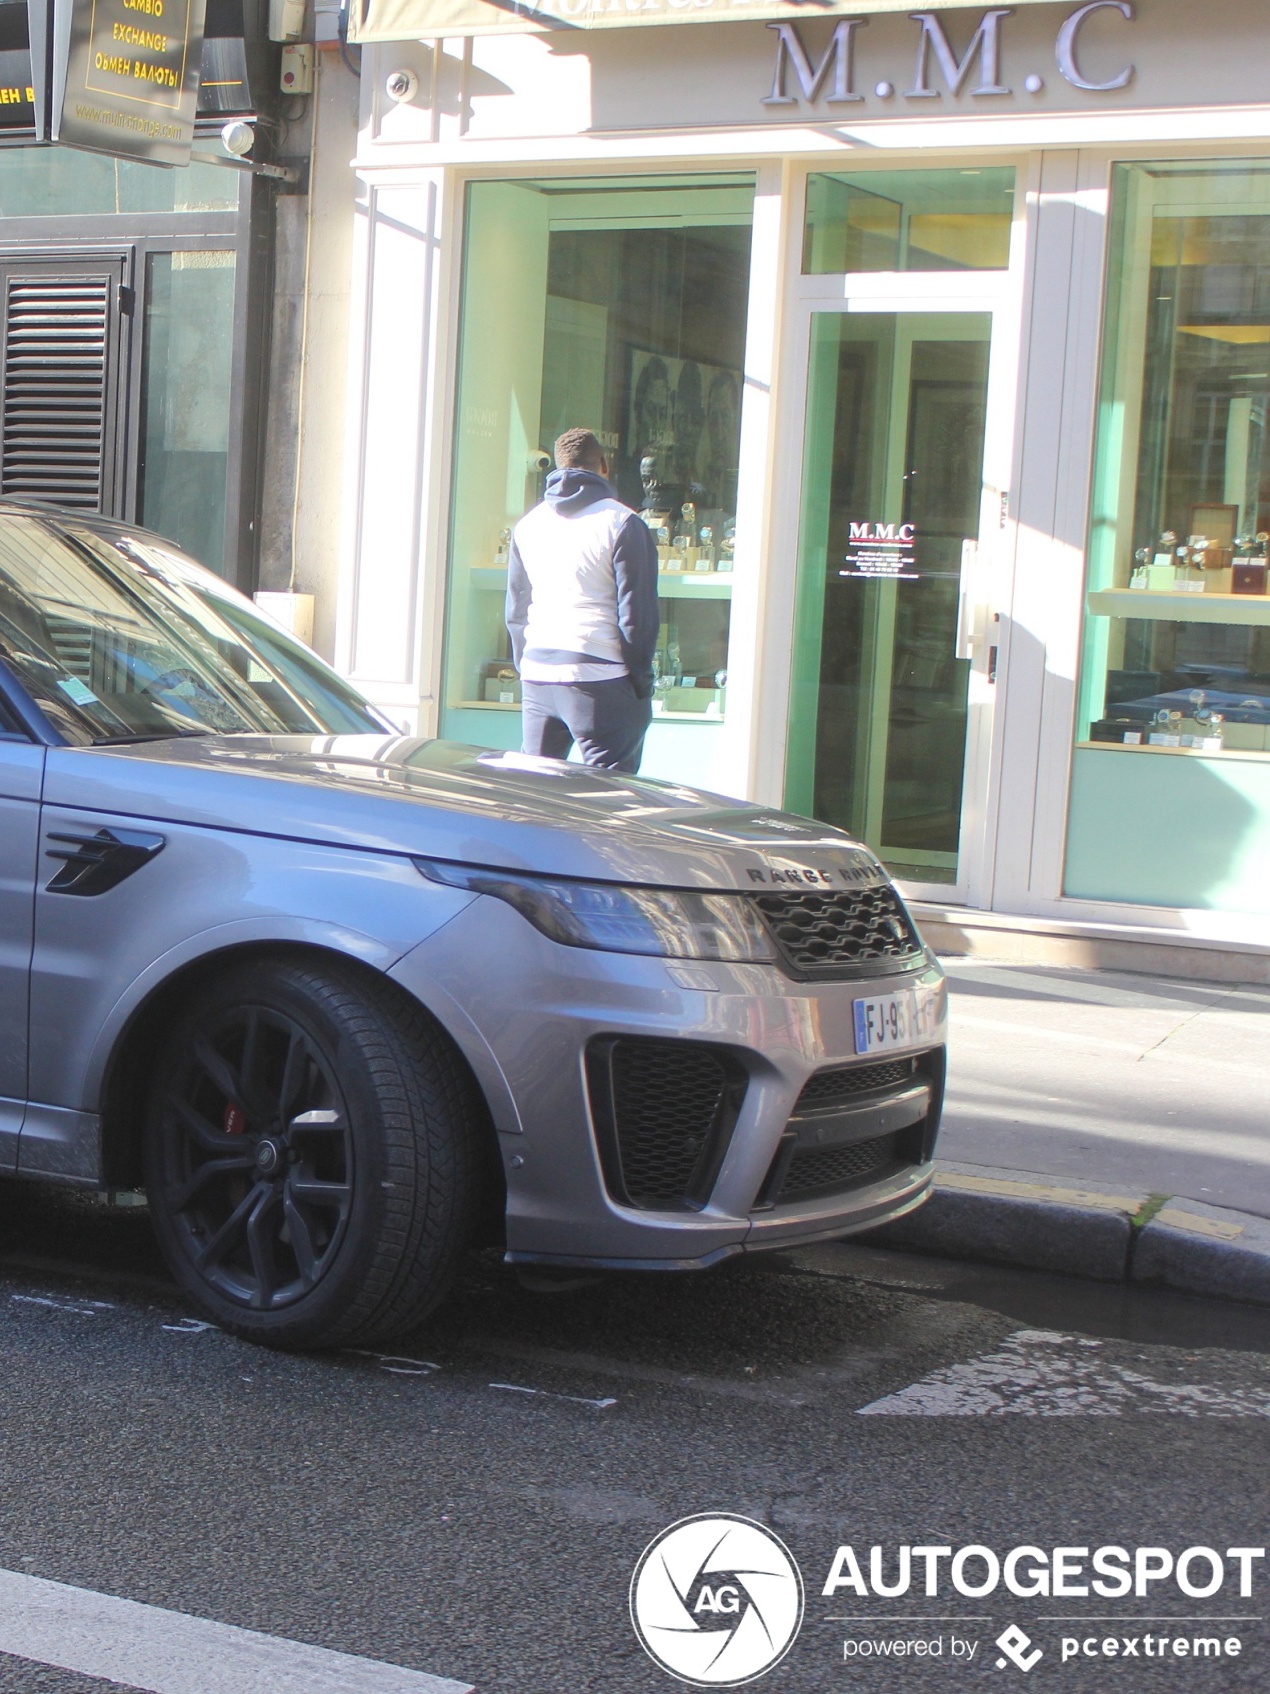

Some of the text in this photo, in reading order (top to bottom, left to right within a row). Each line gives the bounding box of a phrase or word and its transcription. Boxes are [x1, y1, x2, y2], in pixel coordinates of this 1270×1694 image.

[113, 23, 168, 52] EXCHANGE
[760, 0, 1137, 104] M.M.C
[95, 52, 179, 88] ОБМЕН ВАЛЮТЫ
[848, 522, 915, 540] M.M.C
[746, 868, 834, 883] RANGE
